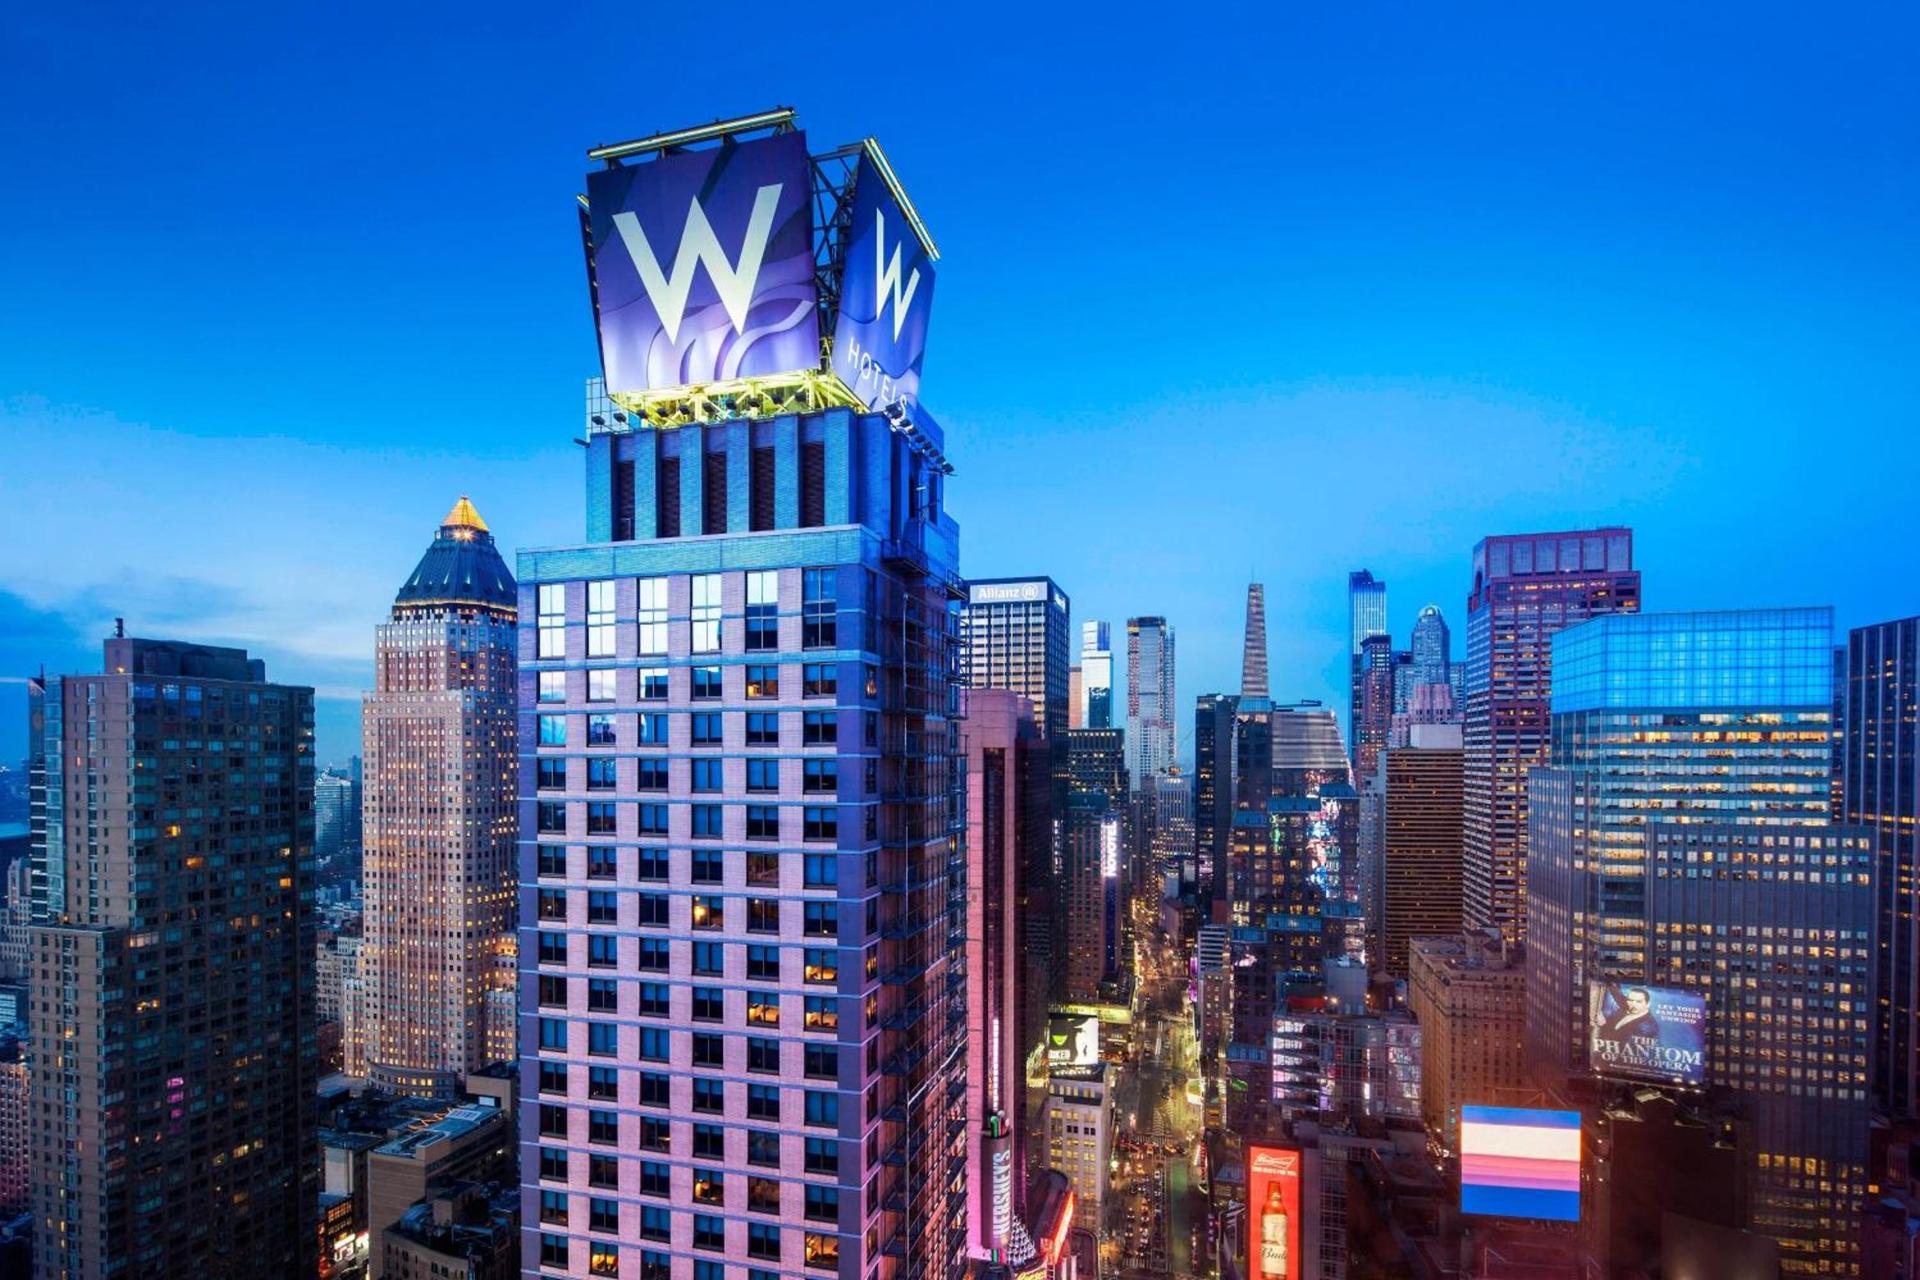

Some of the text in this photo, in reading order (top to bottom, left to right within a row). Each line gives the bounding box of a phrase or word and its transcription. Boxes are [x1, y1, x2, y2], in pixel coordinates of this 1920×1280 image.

[612, 183, 783, 345] W
[876, 207, 920, 343] W
[847, 336, 907, 420] HOTELS
[979, 586, 1020, 600] Allianz
[1591, 1038, 1702, 1066] PHANTOM
[1601, 1051, 1618, 1062] OF
[1621, 1055, 1647, 1066] THE
[1648, 1059, 1692, 1073] OPERA
[1631, 1035, 1658, 1047] THE
[993, 1149, 1011, 1234] HERSHEY'S
